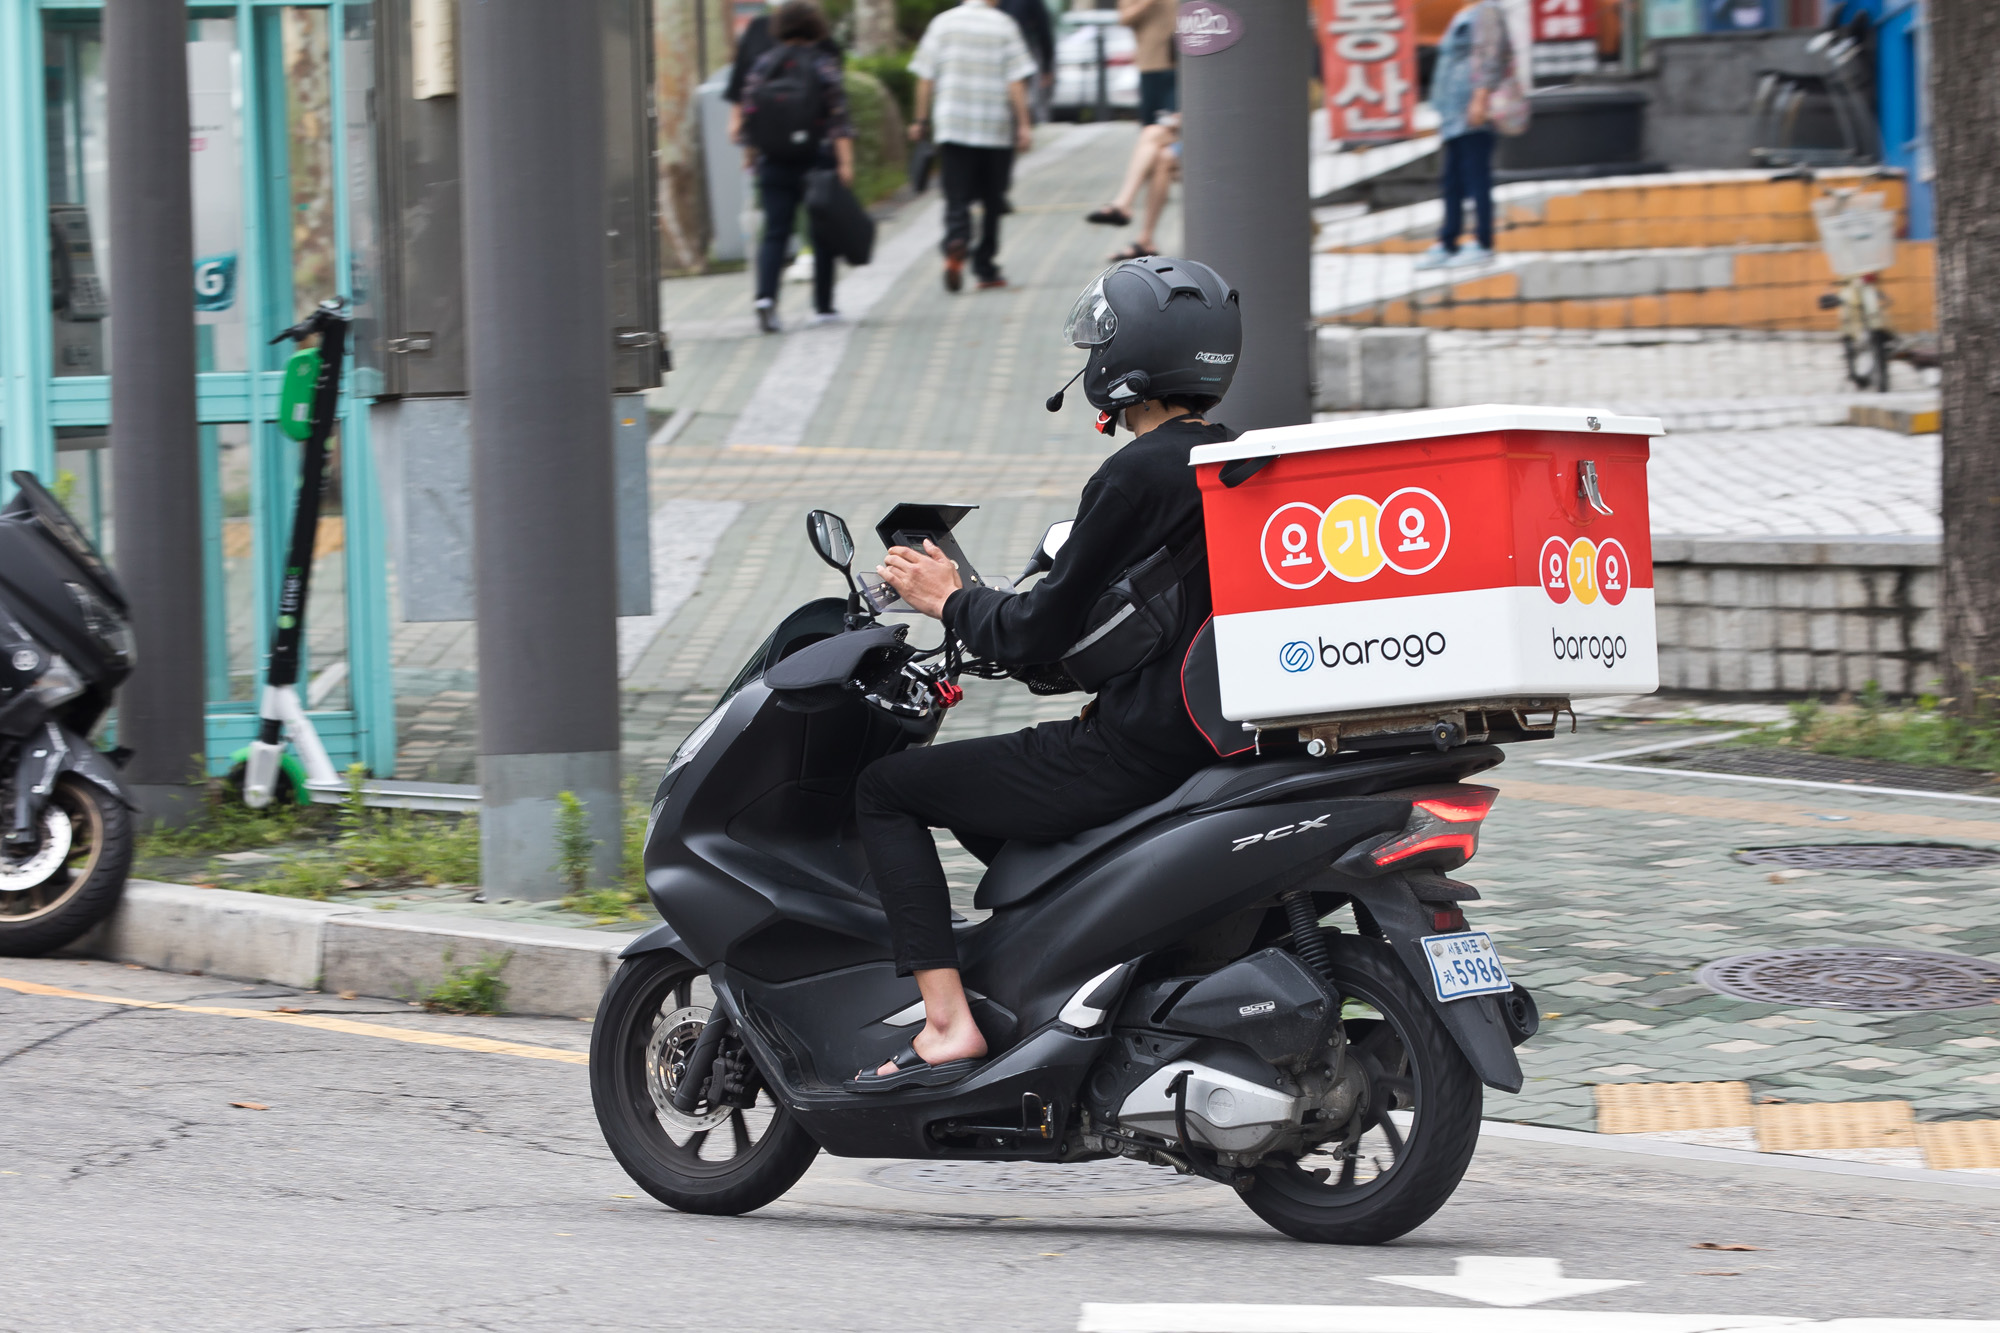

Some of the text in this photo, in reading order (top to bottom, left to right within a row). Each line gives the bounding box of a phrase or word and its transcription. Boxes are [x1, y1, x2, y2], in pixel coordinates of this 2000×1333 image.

[1281, 507, 1430, 567] 요기요
[1549, 553, 1622, 590] 요기요
[1318, 631, 1447, 668] barogo
[1551, 626, 1627, 669] barogo
[1231, 813, 1331, 852] PCX
[1452, 957, 1503, 986] 5986
